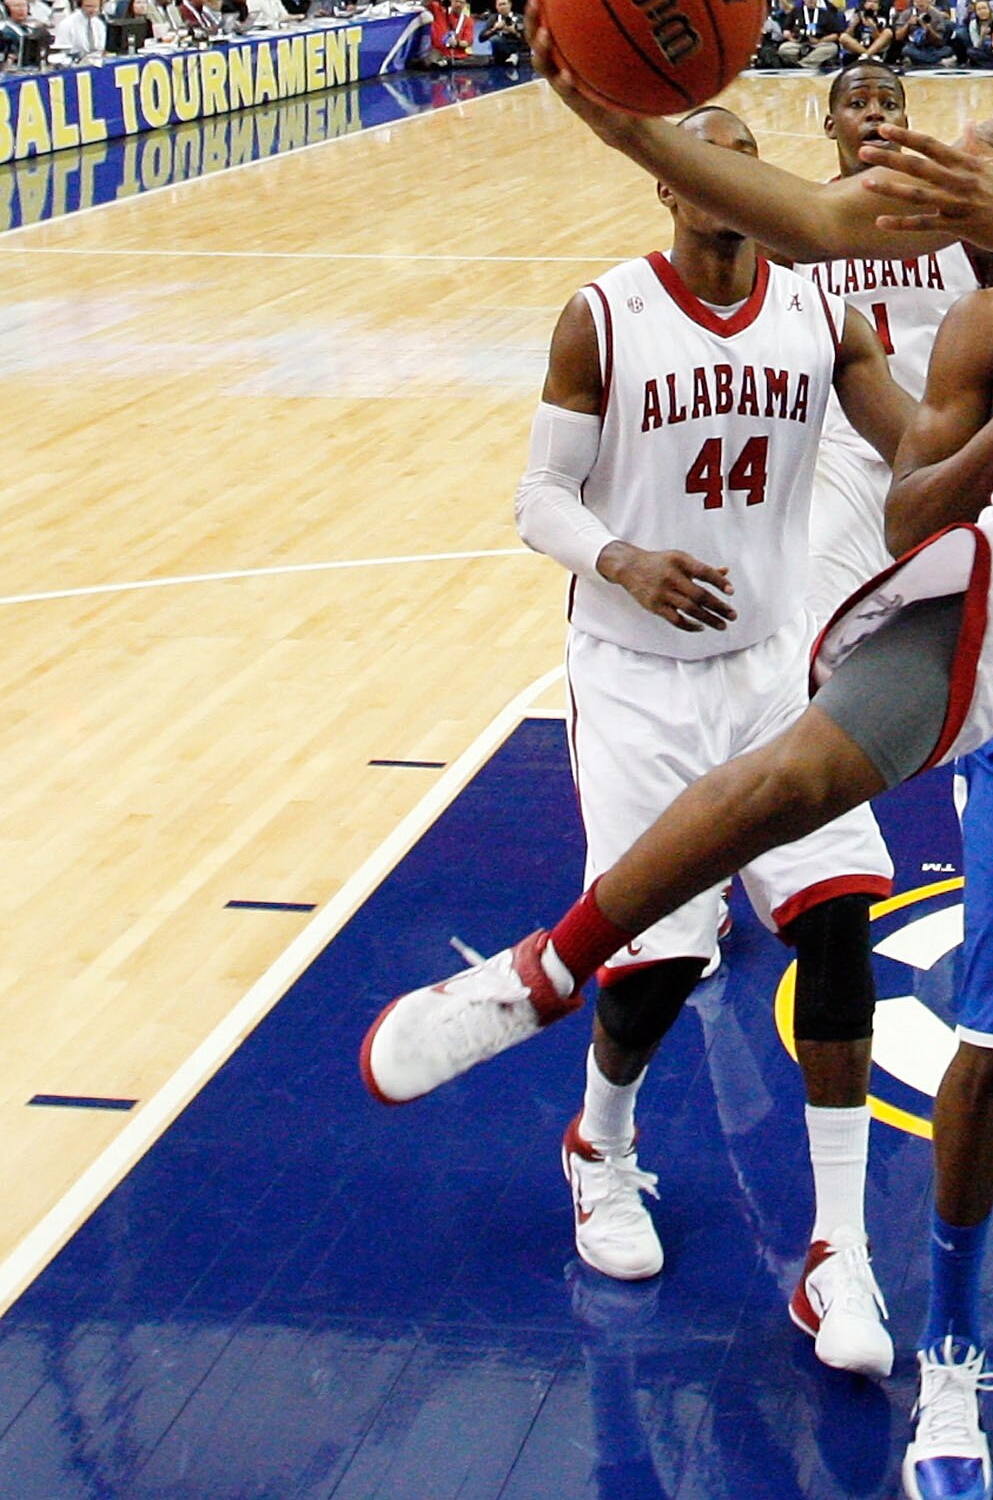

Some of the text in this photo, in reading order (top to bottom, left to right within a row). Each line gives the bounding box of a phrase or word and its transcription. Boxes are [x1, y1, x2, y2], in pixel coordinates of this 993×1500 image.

[115, 26, 363, 135] TOURNAMENT
[642, 364, 810, 432] ALABAMA
[686, 436, 769, 509] 44
